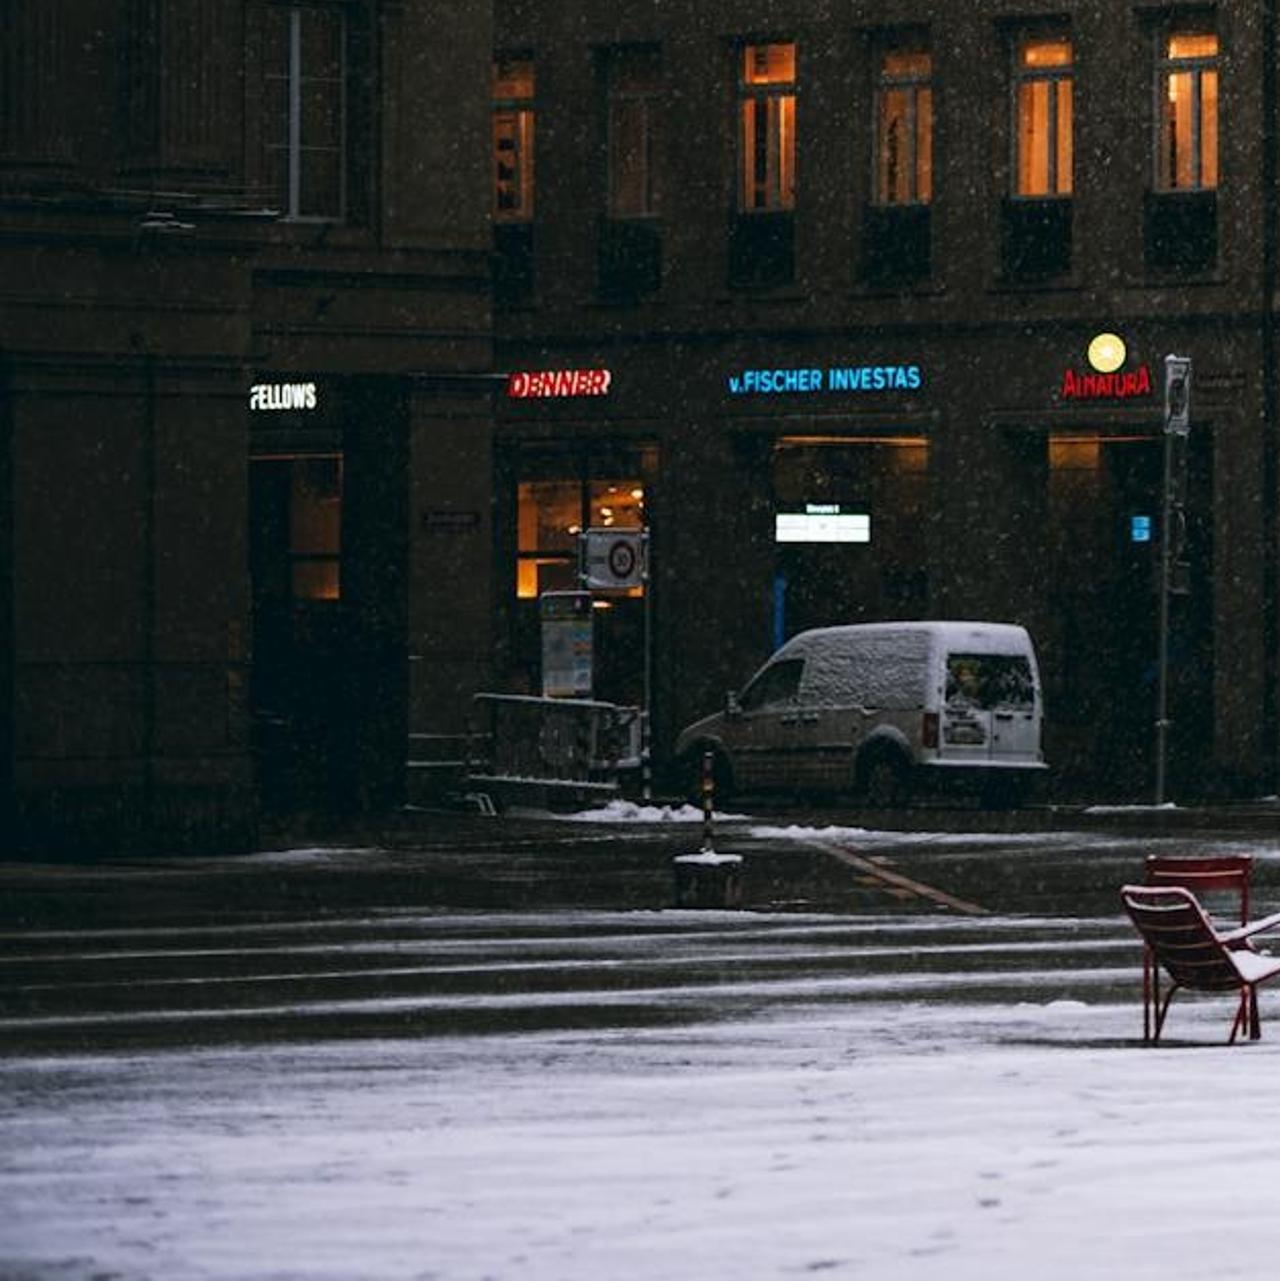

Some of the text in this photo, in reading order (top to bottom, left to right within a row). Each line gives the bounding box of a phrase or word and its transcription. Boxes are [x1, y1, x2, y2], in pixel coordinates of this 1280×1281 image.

[508, 369, 611, 397] DENNER
[729, 366, 920, 393] v.FISCHER INVESTAS
[250, 382, 317, 410] FELLOWS
